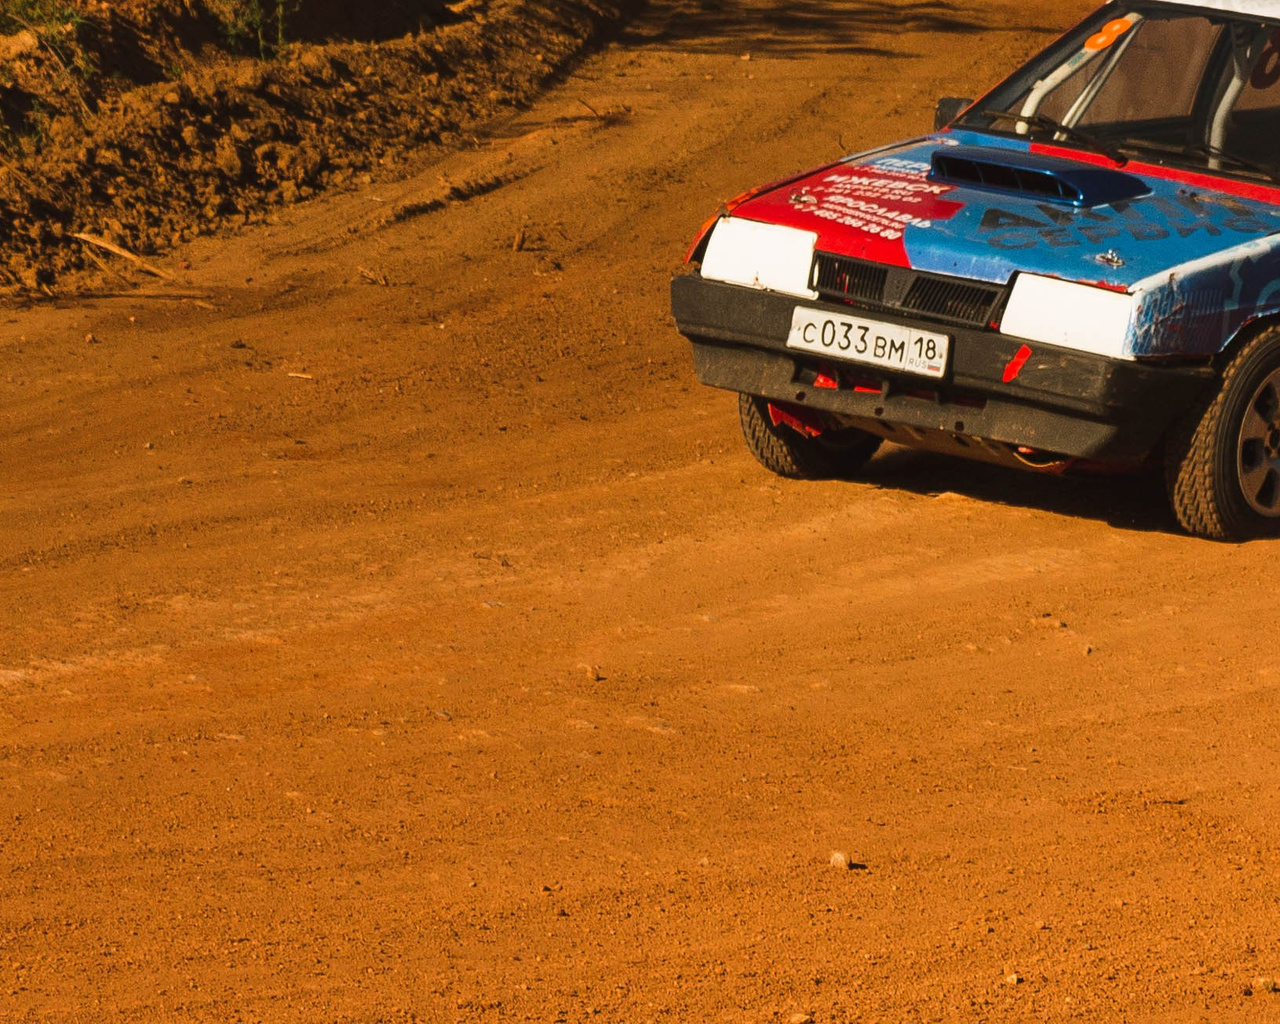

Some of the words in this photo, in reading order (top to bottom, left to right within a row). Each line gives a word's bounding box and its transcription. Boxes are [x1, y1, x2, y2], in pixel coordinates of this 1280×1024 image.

[1084, 18, 1132, 51] 8
[823, 175, 950, 194] ИЖЕВСК
[822, 194, 932, 229] ЯРОСЛАВЛЬ
[986, 218, 1273, 250] СЕРВИС
[914, 337, 936, 360] 18
[909, 357, 927, 369] RUS
